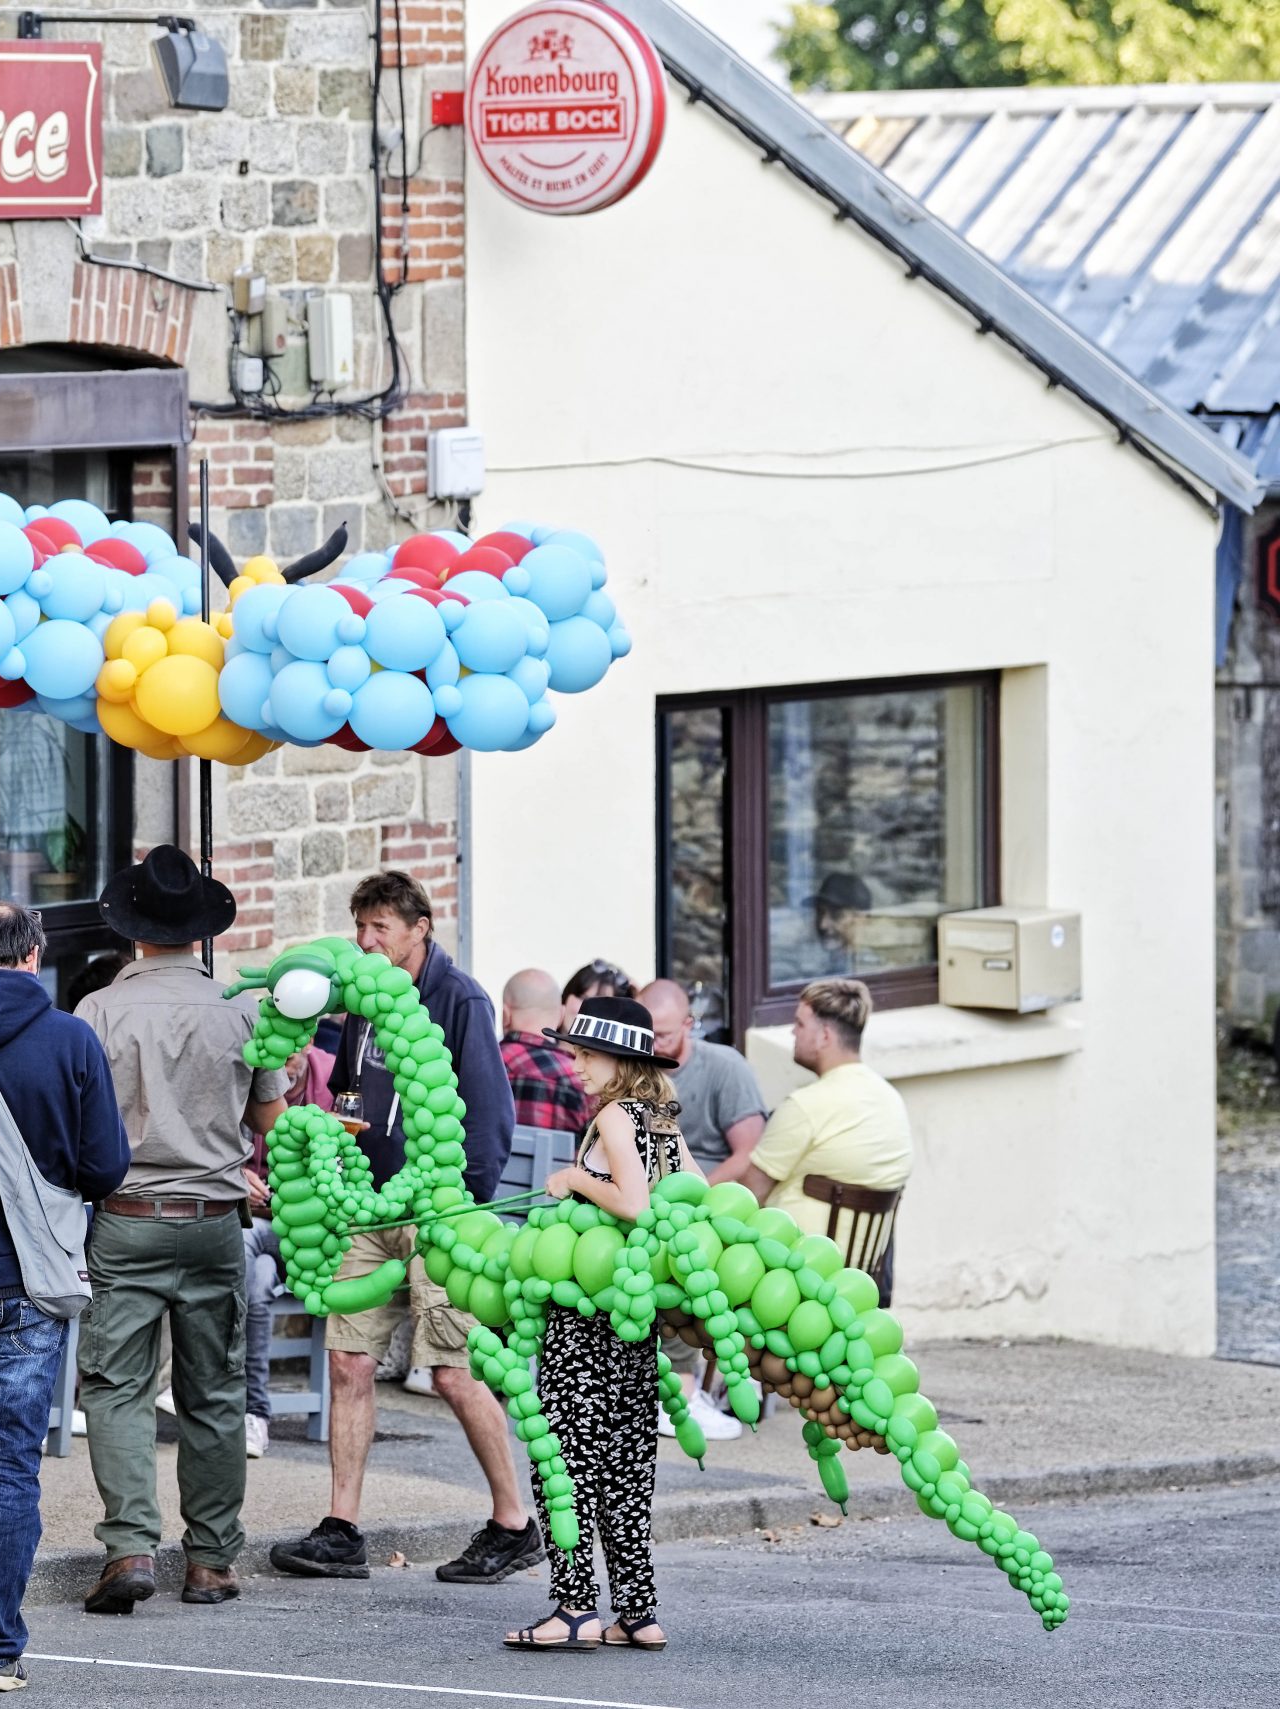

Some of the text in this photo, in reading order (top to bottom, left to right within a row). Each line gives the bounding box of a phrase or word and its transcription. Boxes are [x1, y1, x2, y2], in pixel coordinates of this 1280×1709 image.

[486, 64, 618, 99] Kronenbourg
[487, 109, 617, 133] TIGRE BOCK
